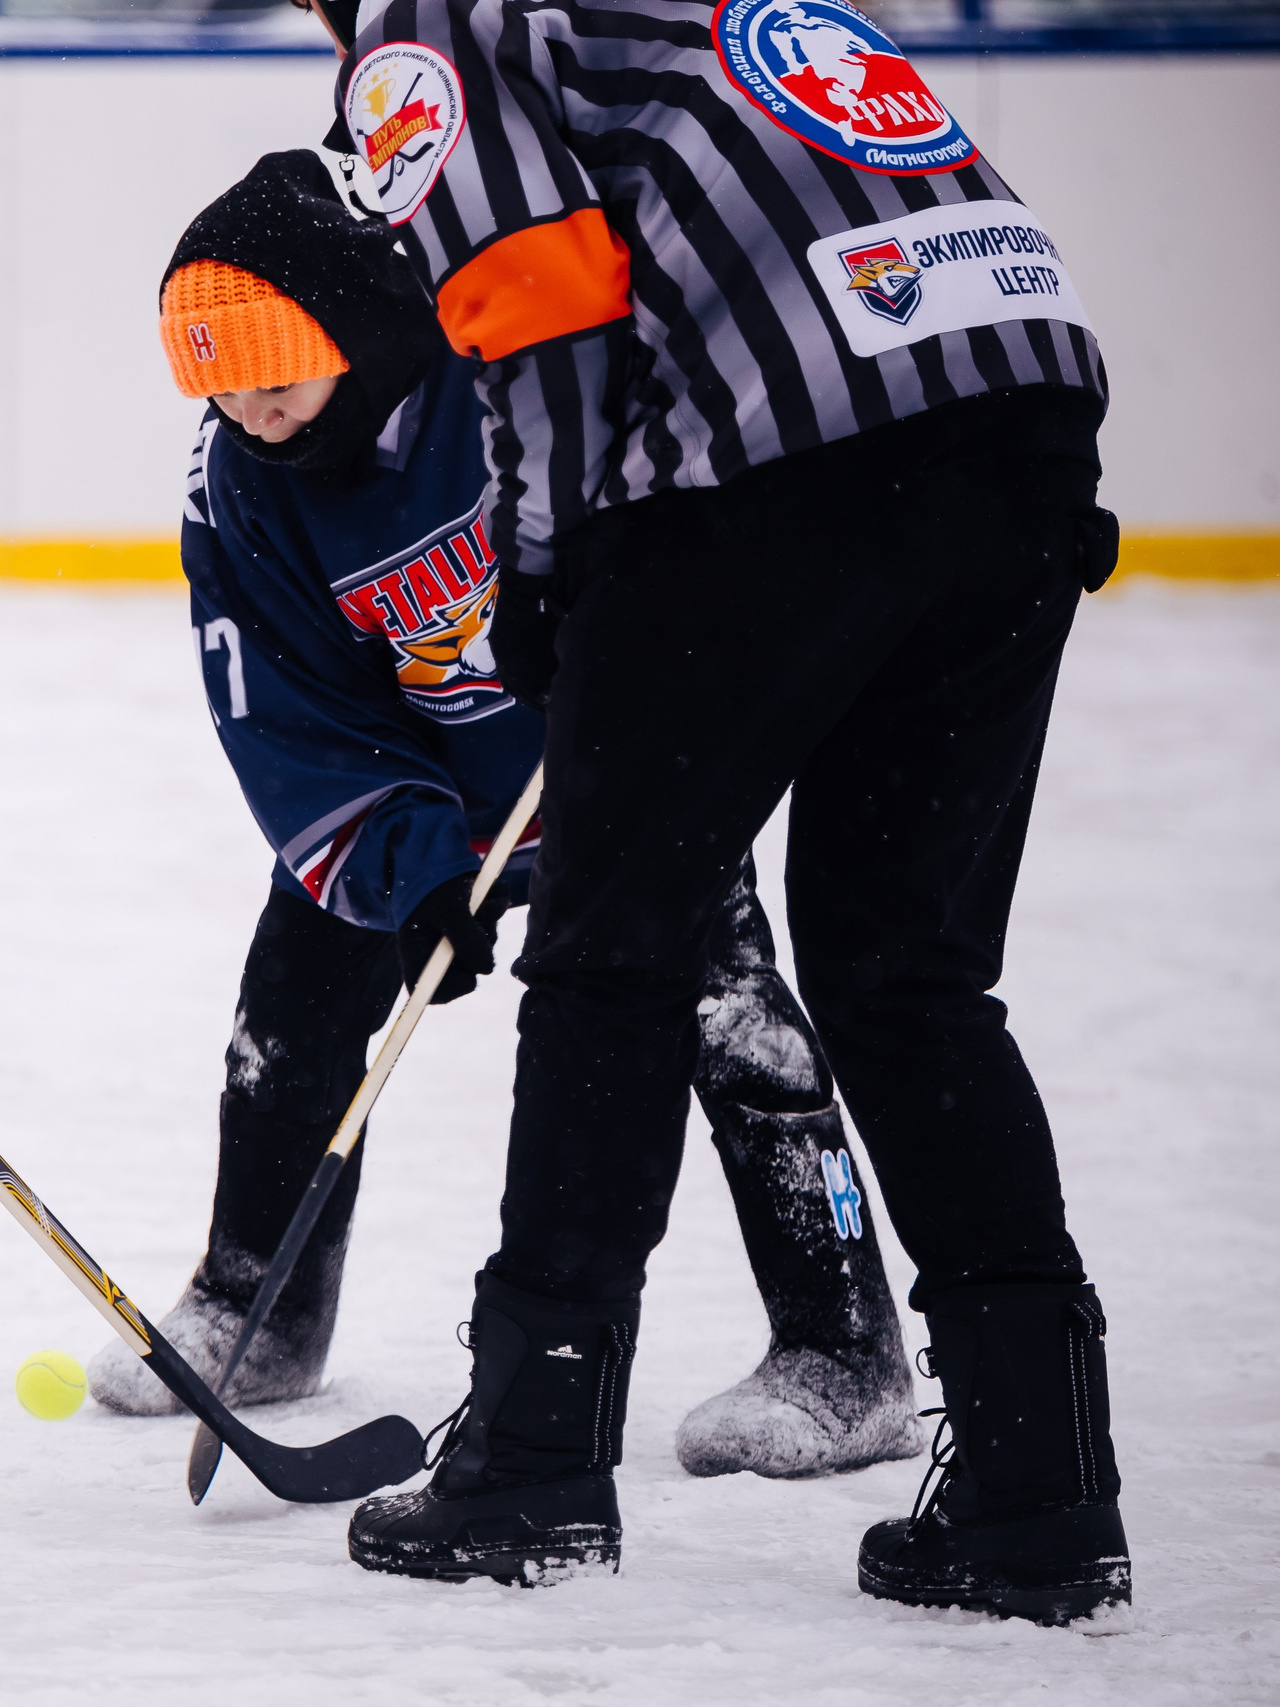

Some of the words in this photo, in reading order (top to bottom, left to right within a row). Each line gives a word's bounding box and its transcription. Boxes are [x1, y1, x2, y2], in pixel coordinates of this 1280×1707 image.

[725, 0, 761, 35] любите
[363, 50, 401, 74] ДЕТСКОГО
[402, 51, 429, 63] ХОККЕЯ
[427, 59, 438, 69] ПО
[727, 38, 787, 114] Федерация
[437, 66, 458, 120] ЧЕЛЯБИНСКОЙ
[372, 116, 402, 149] ПУТЬ
[433, 121, 455, 159] ОБЛАСТИ
[991, 265, 1060, 296] ЦЕНТР
[405, 694, 475, 713] MAGNITOGORSK
[546, 1349, 583, 1360] Nordman
